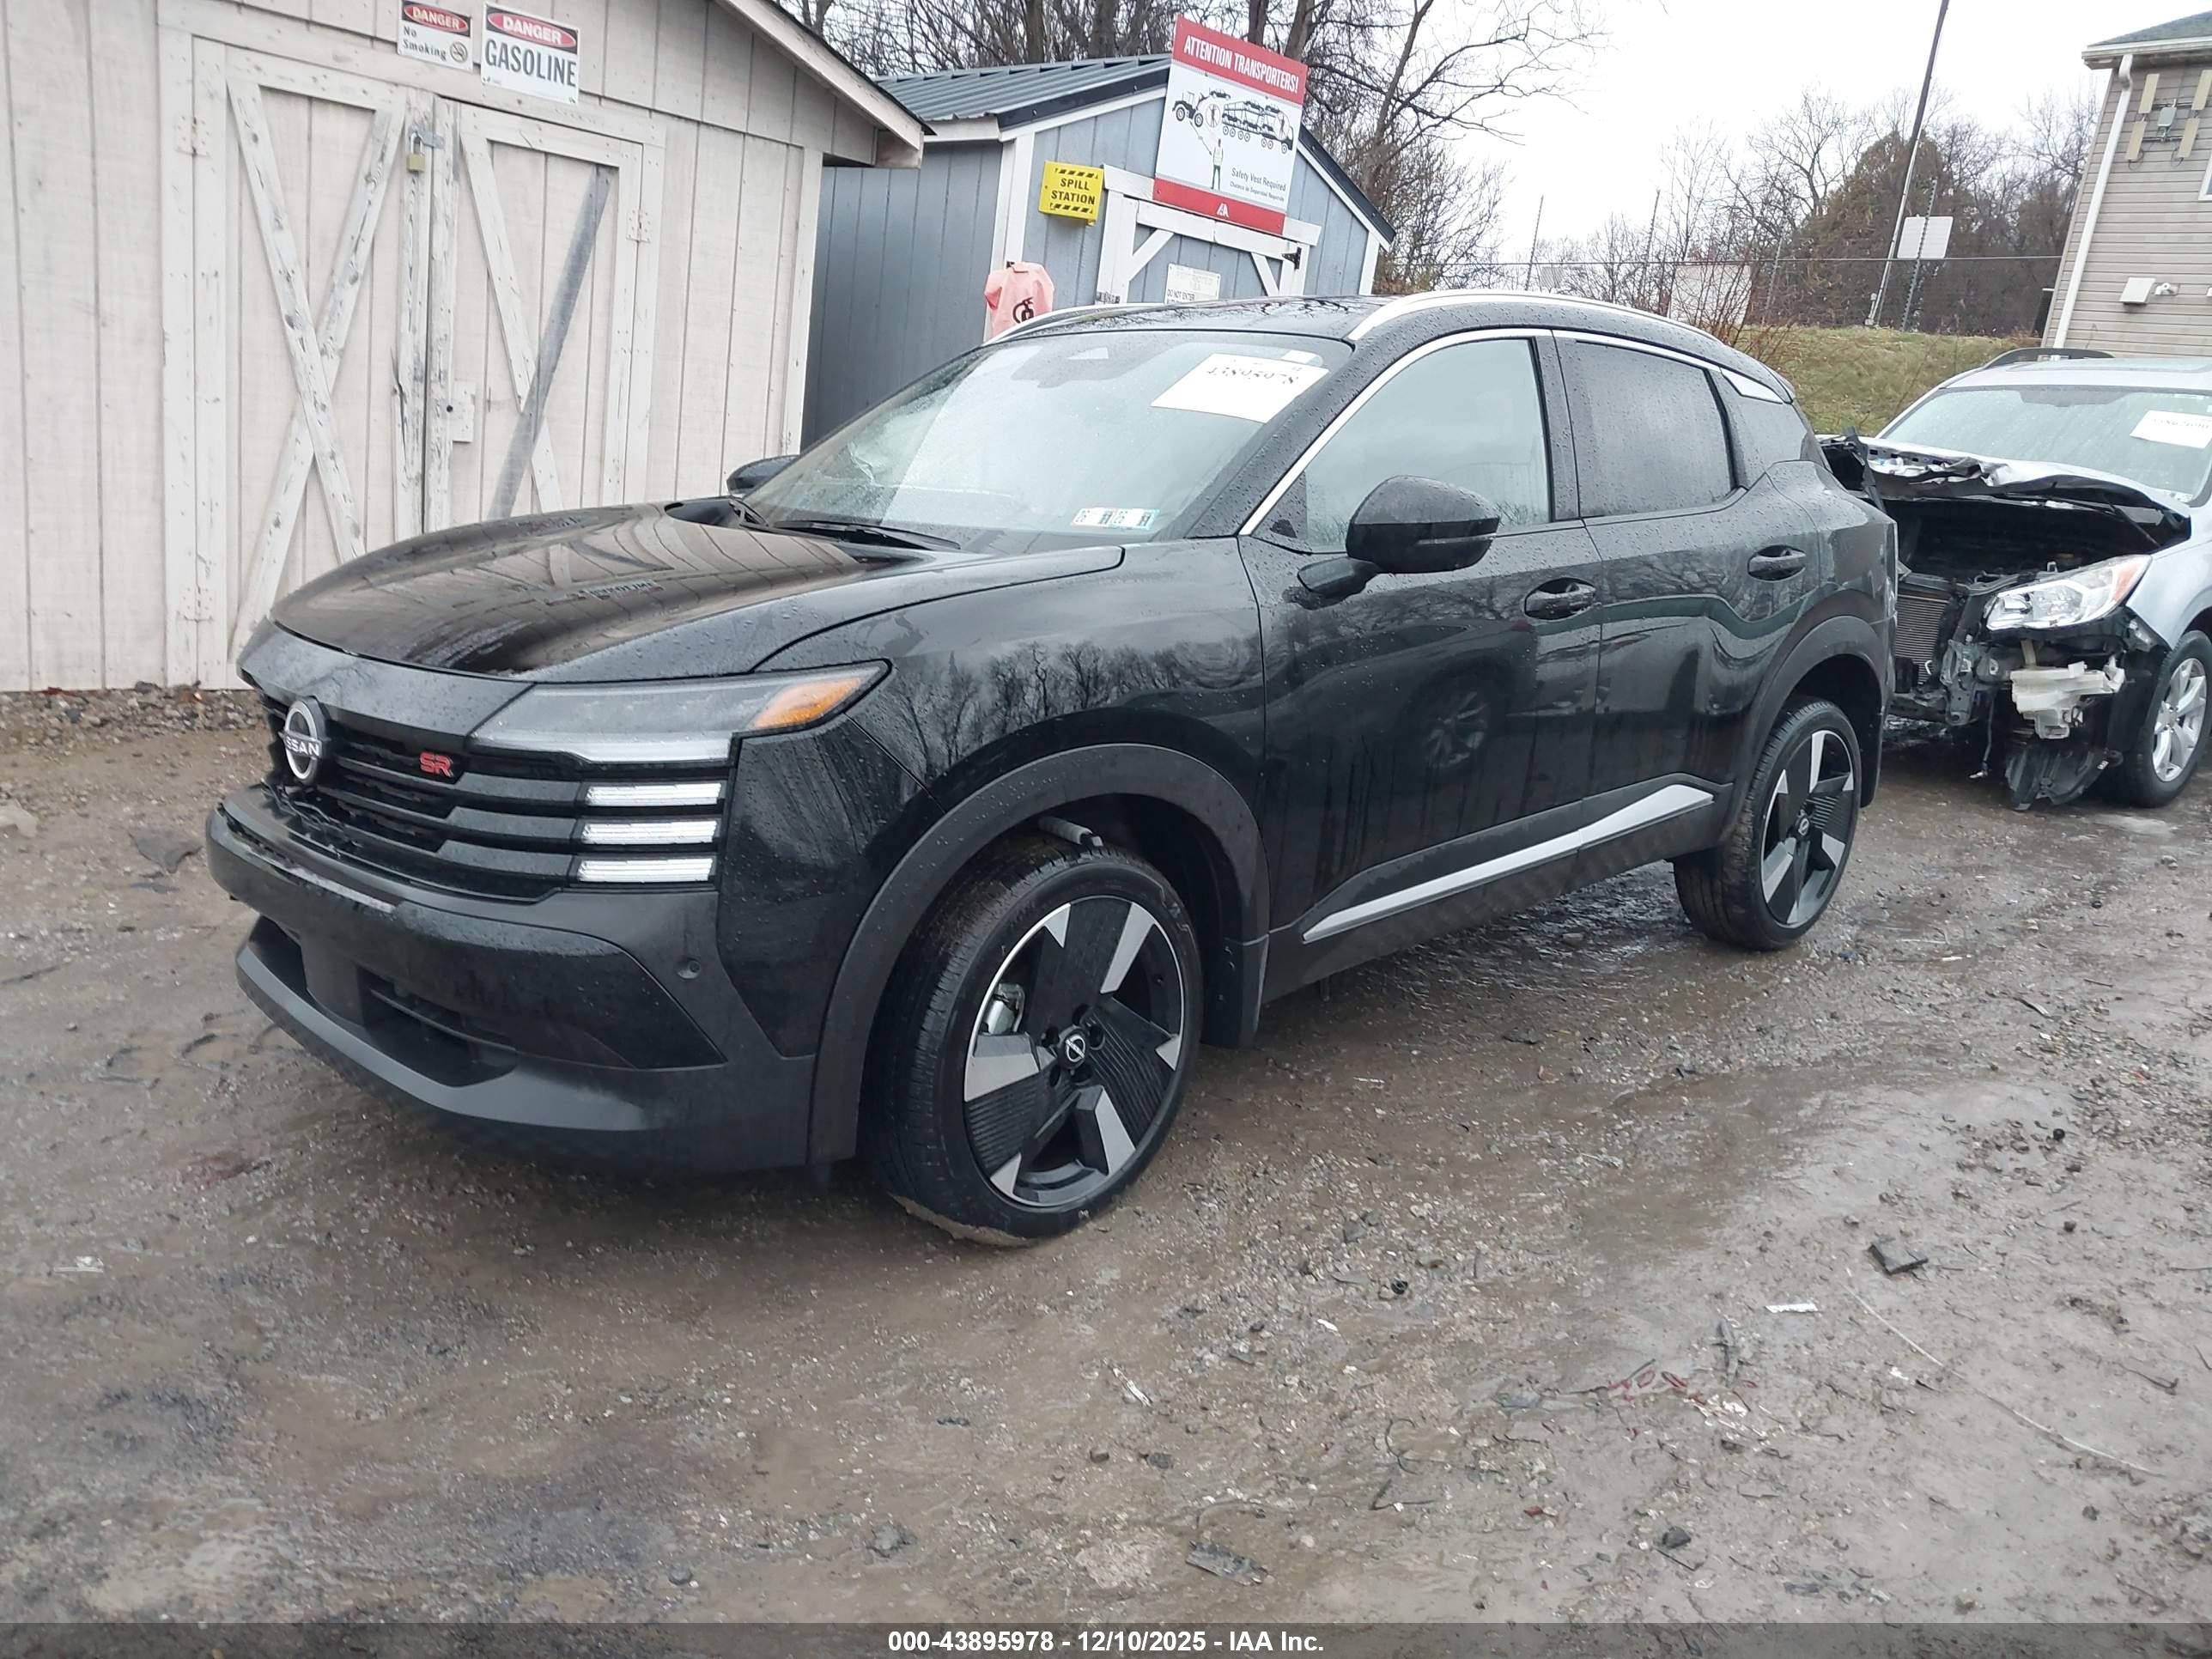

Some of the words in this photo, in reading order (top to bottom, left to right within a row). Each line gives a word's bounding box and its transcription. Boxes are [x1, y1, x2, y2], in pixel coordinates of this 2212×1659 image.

[412, 7, 459, 30] DANGER
[503, 15, 562, 45] DANGER
[403, 26, 417, 38] No
[403, 39, 447, 61] Smoking
[484, 39, 577, 87] GASOLINE
[1184, 34, 1233, 70] ATTENTION
[1234, 53, 1299, 94] TRANSPORTERS!
[1060, 177, 1091, 191] SPILL
[1231, 167, 1249, 182] Safety
[1250, 173, 1262, 185] Vest
[1262, 176, 1286, 191] Required
[1050, 190, 1096, 205] STATION
[419, 751, 453, 778] SR
